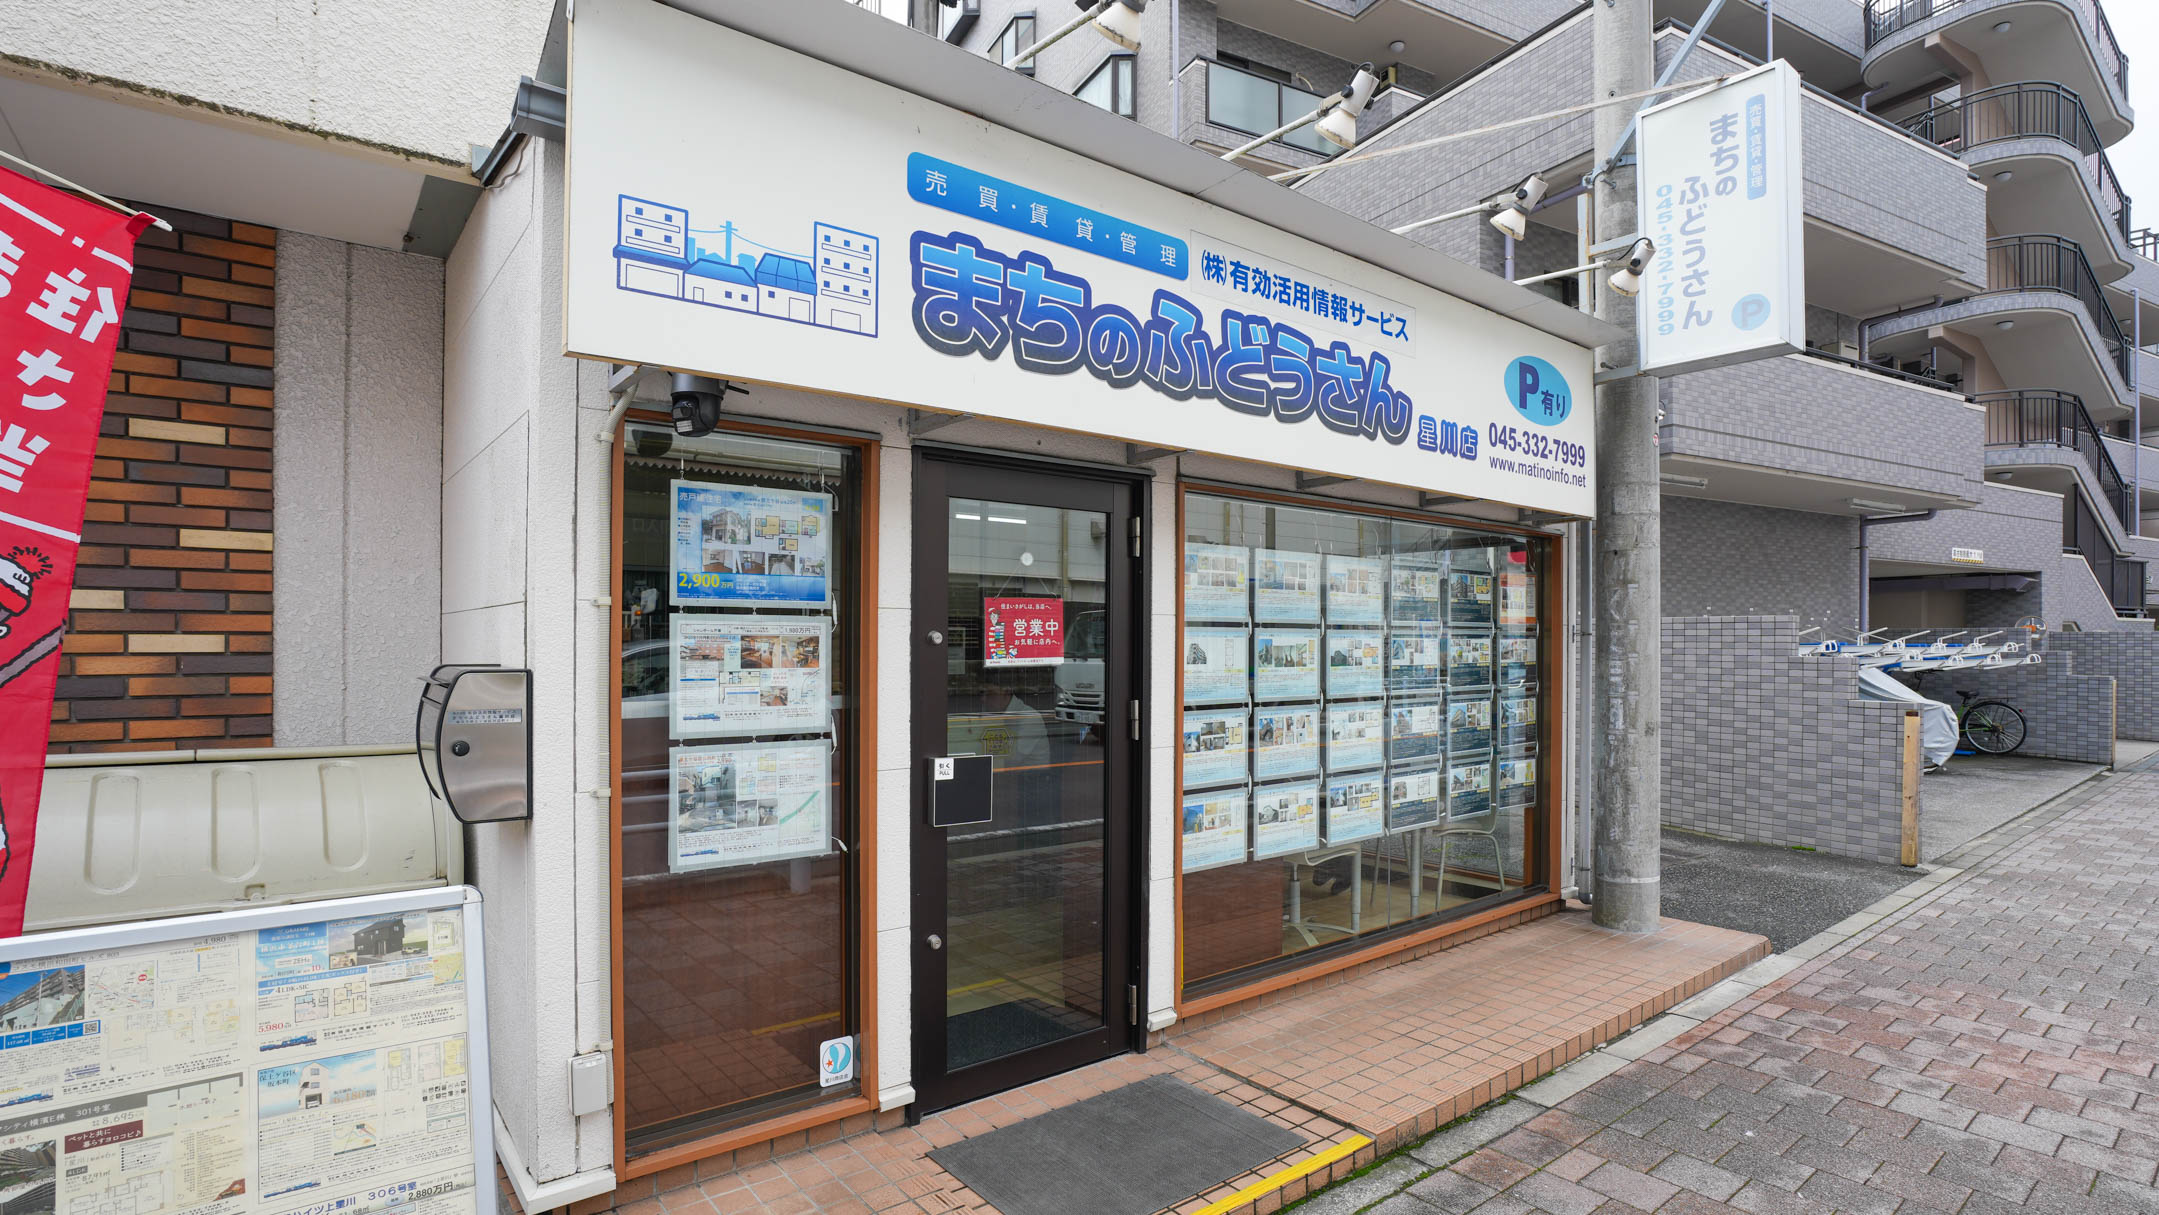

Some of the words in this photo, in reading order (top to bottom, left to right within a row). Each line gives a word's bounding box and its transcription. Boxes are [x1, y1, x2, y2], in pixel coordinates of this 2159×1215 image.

[1709, 112, 1739, 196] まちの
[925, 169, 1176, 267] 売買・賃貸・管理
[1678, 175, 1713, 330] ふどうさん
[1202, 250, 1409, 342] (株)有効活用情報サービス
[1741, 299, 1764, 328] P
[911, 231, 1412, 444] まちのふどうさん
[1418, 414, 1479, 461] 星川店
[1489, 422, 1586, 468] 045-332-7999
[1489, 455, 1587, 488] www.matinoinfo.net
[679, 573, 720, 588] 2,900
[1013, 618, 1059, 636] 営業中
[76, 1103, 112, 1117] 301号室
[68, 1128, 112, 1142] ペットと共に
[368, 1181, 417, 1200] 306号室
[408, 1181, 453, 1201] 2,880万円
